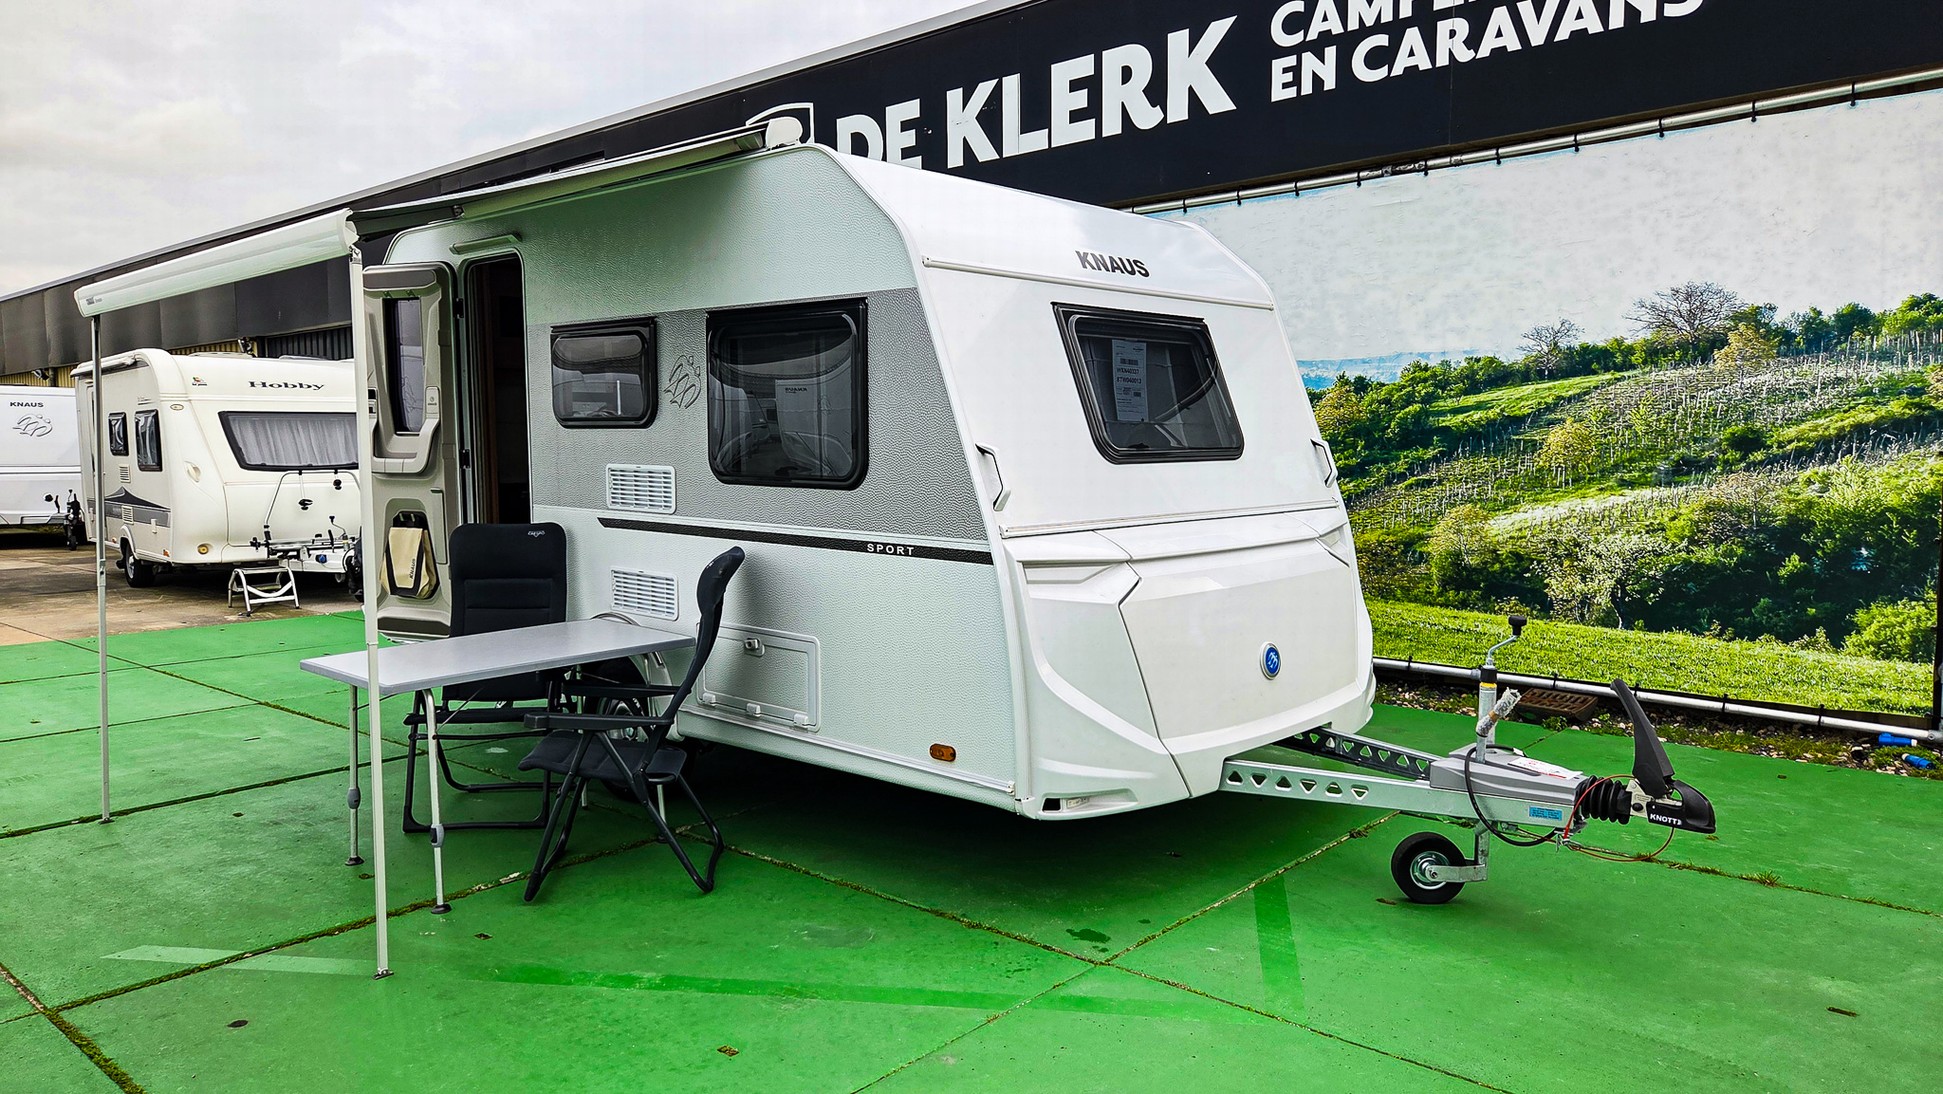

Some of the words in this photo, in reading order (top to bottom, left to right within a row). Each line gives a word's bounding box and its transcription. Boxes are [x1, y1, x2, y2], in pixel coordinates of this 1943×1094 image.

[1271, 45, 1336, 102] EN
[836, 98, 922, 170] DE
[946, 15, 1237, 168] KLERK
[1075, 250, 1150, 278] KNAUS
[248, 381, 325, 391] Hobby
[867, 543, 914, 556] SPORT
[1650, 813, 1678, 825] KNOTT
